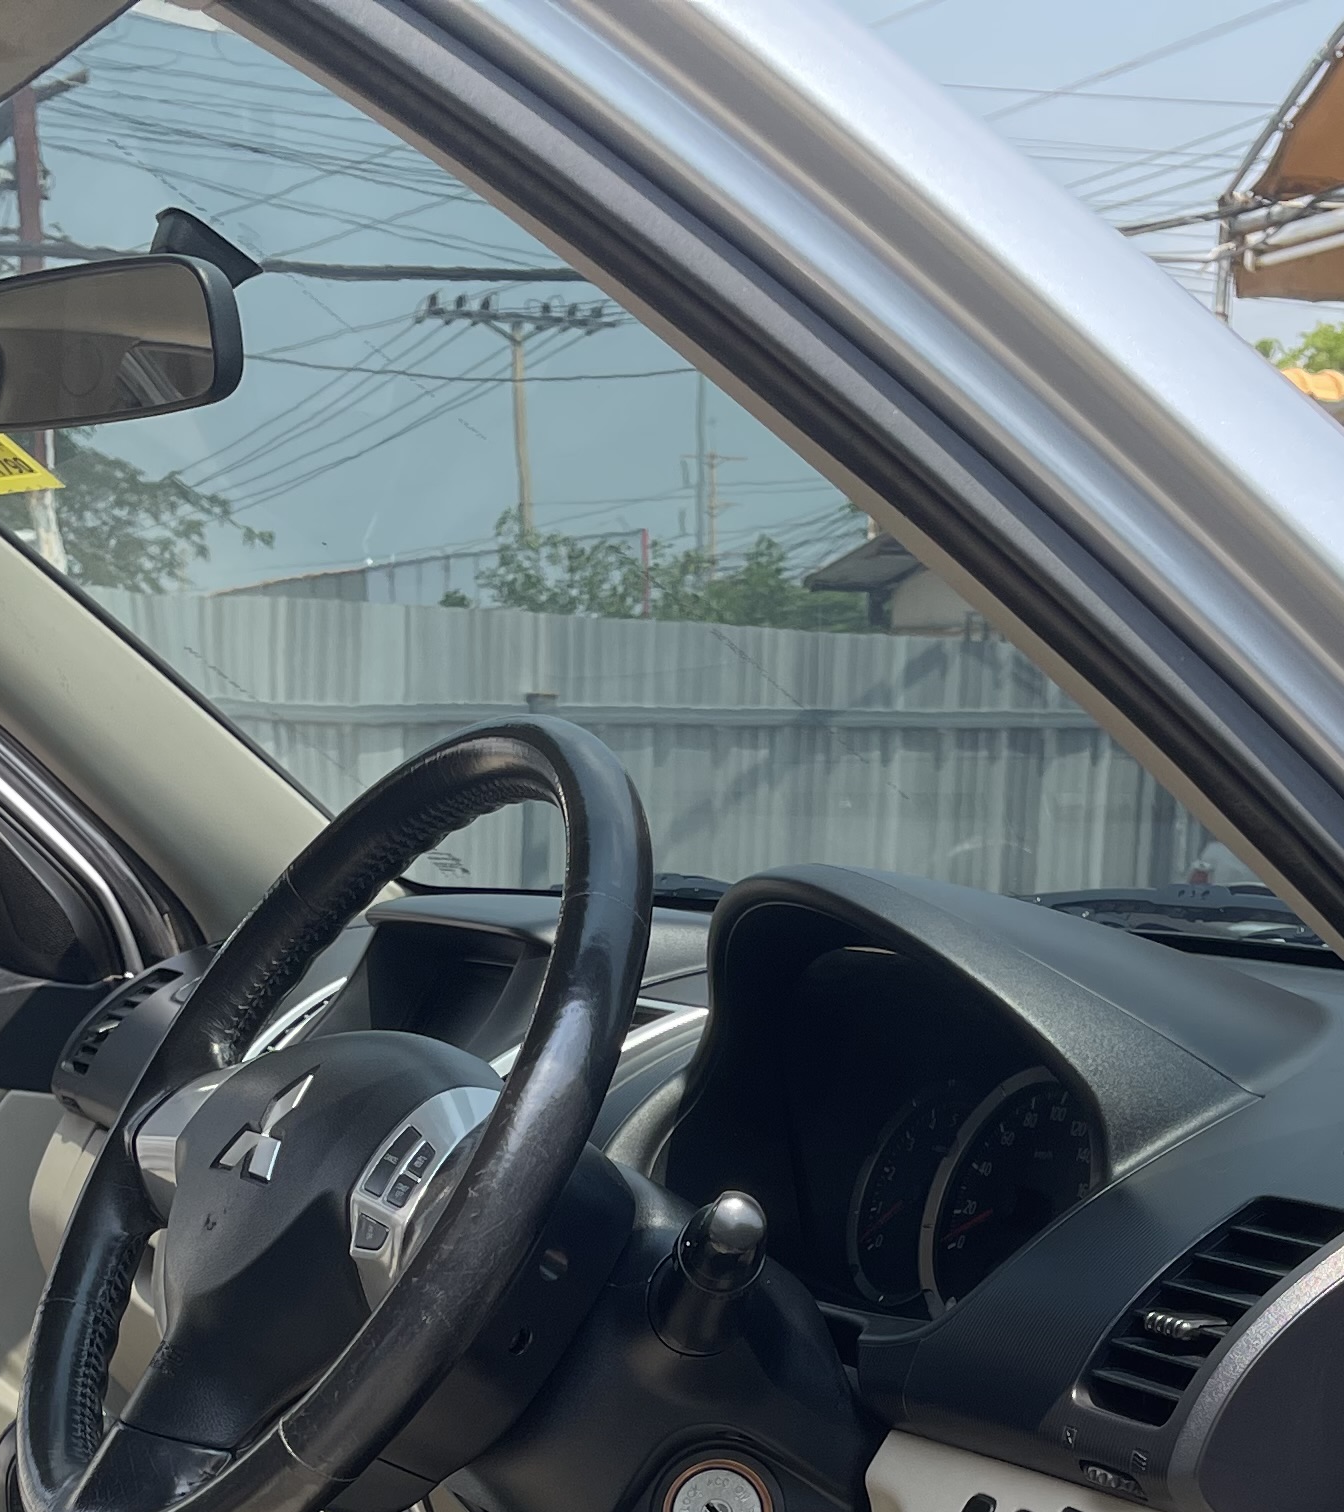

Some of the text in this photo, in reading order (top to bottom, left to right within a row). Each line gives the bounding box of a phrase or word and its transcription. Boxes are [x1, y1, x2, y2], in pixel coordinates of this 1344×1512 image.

[1023, 1111, 1038, 1128] 80
[1070, 1121, 1087, 1136] 120
[1000, 1131, 1015, 1146] 60
[978, 1161, 992, 1176] 40
[963, 1200, 977, 1215] 20
[956, 1235, 966, 1248] 0
